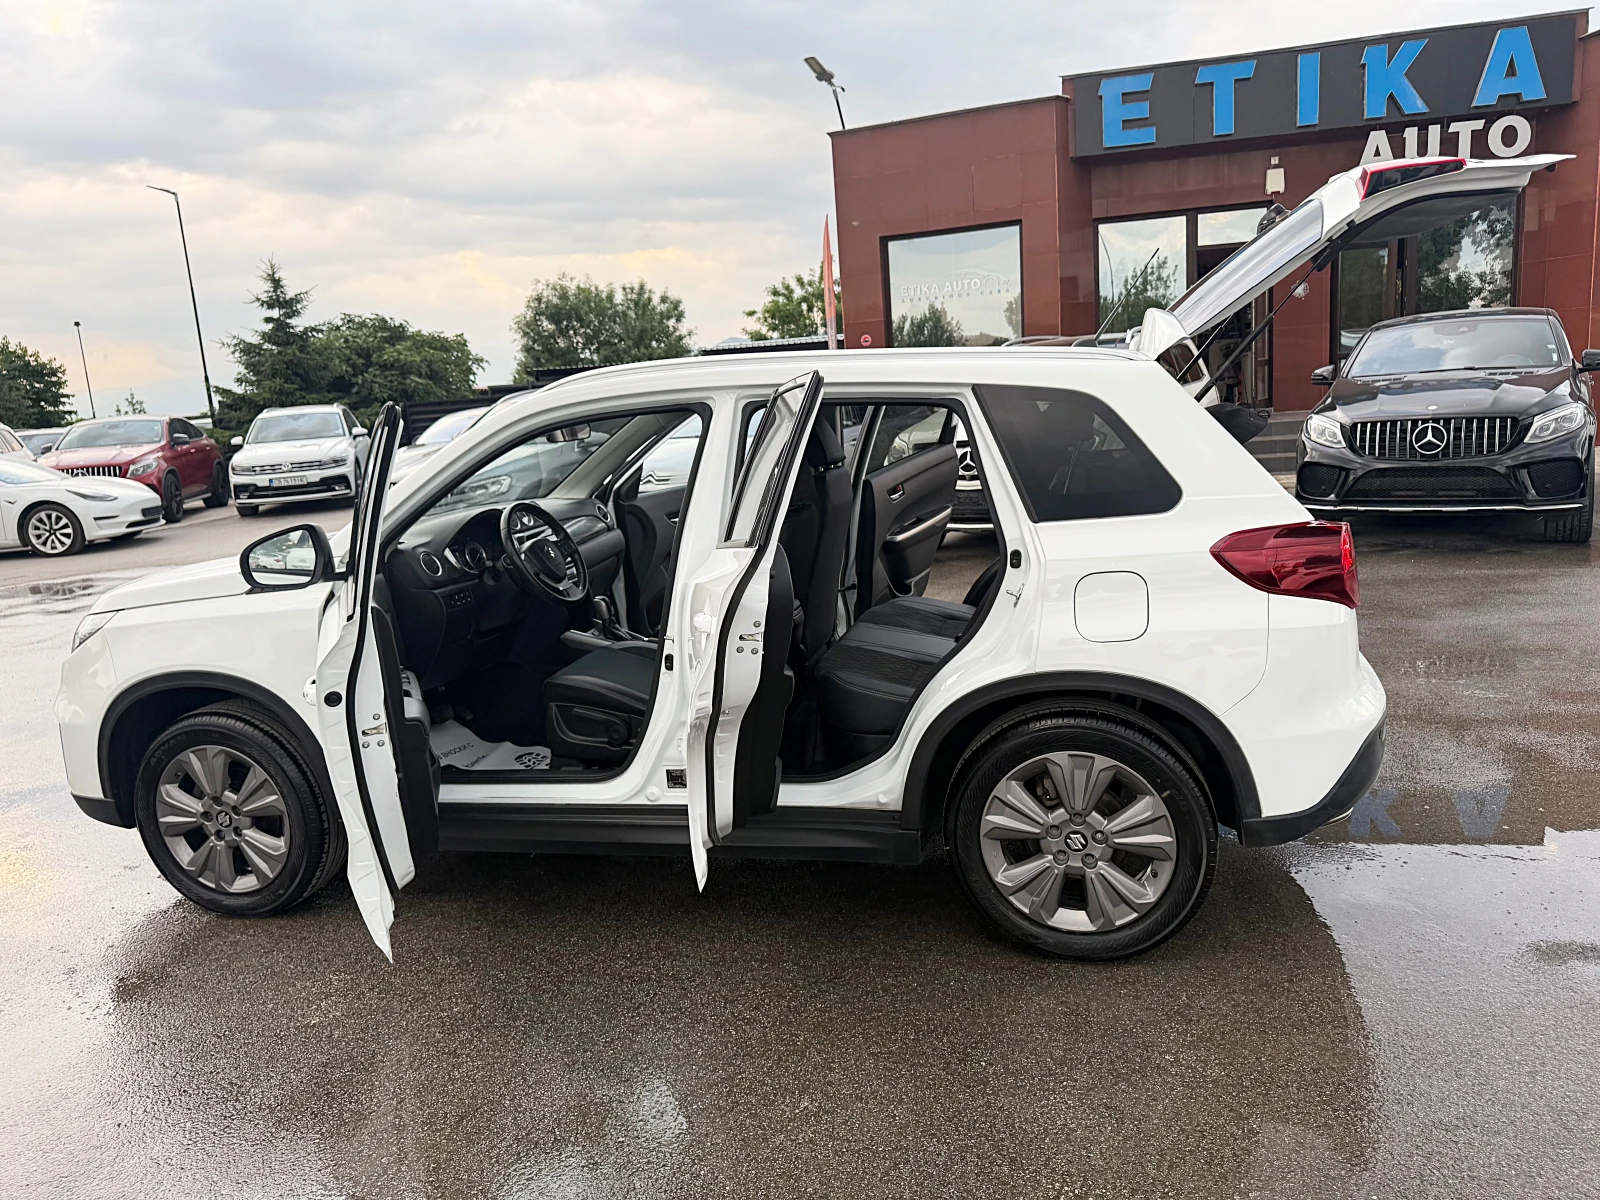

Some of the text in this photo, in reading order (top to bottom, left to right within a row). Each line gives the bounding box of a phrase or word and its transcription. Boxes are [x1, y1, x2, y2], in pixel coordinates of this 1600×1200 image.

[1098, 26, 1547, 148] ETIKA
[1359, 115, 1532, 166] AUTO
[900, 278, 981, 297] ETIKA AUTO
